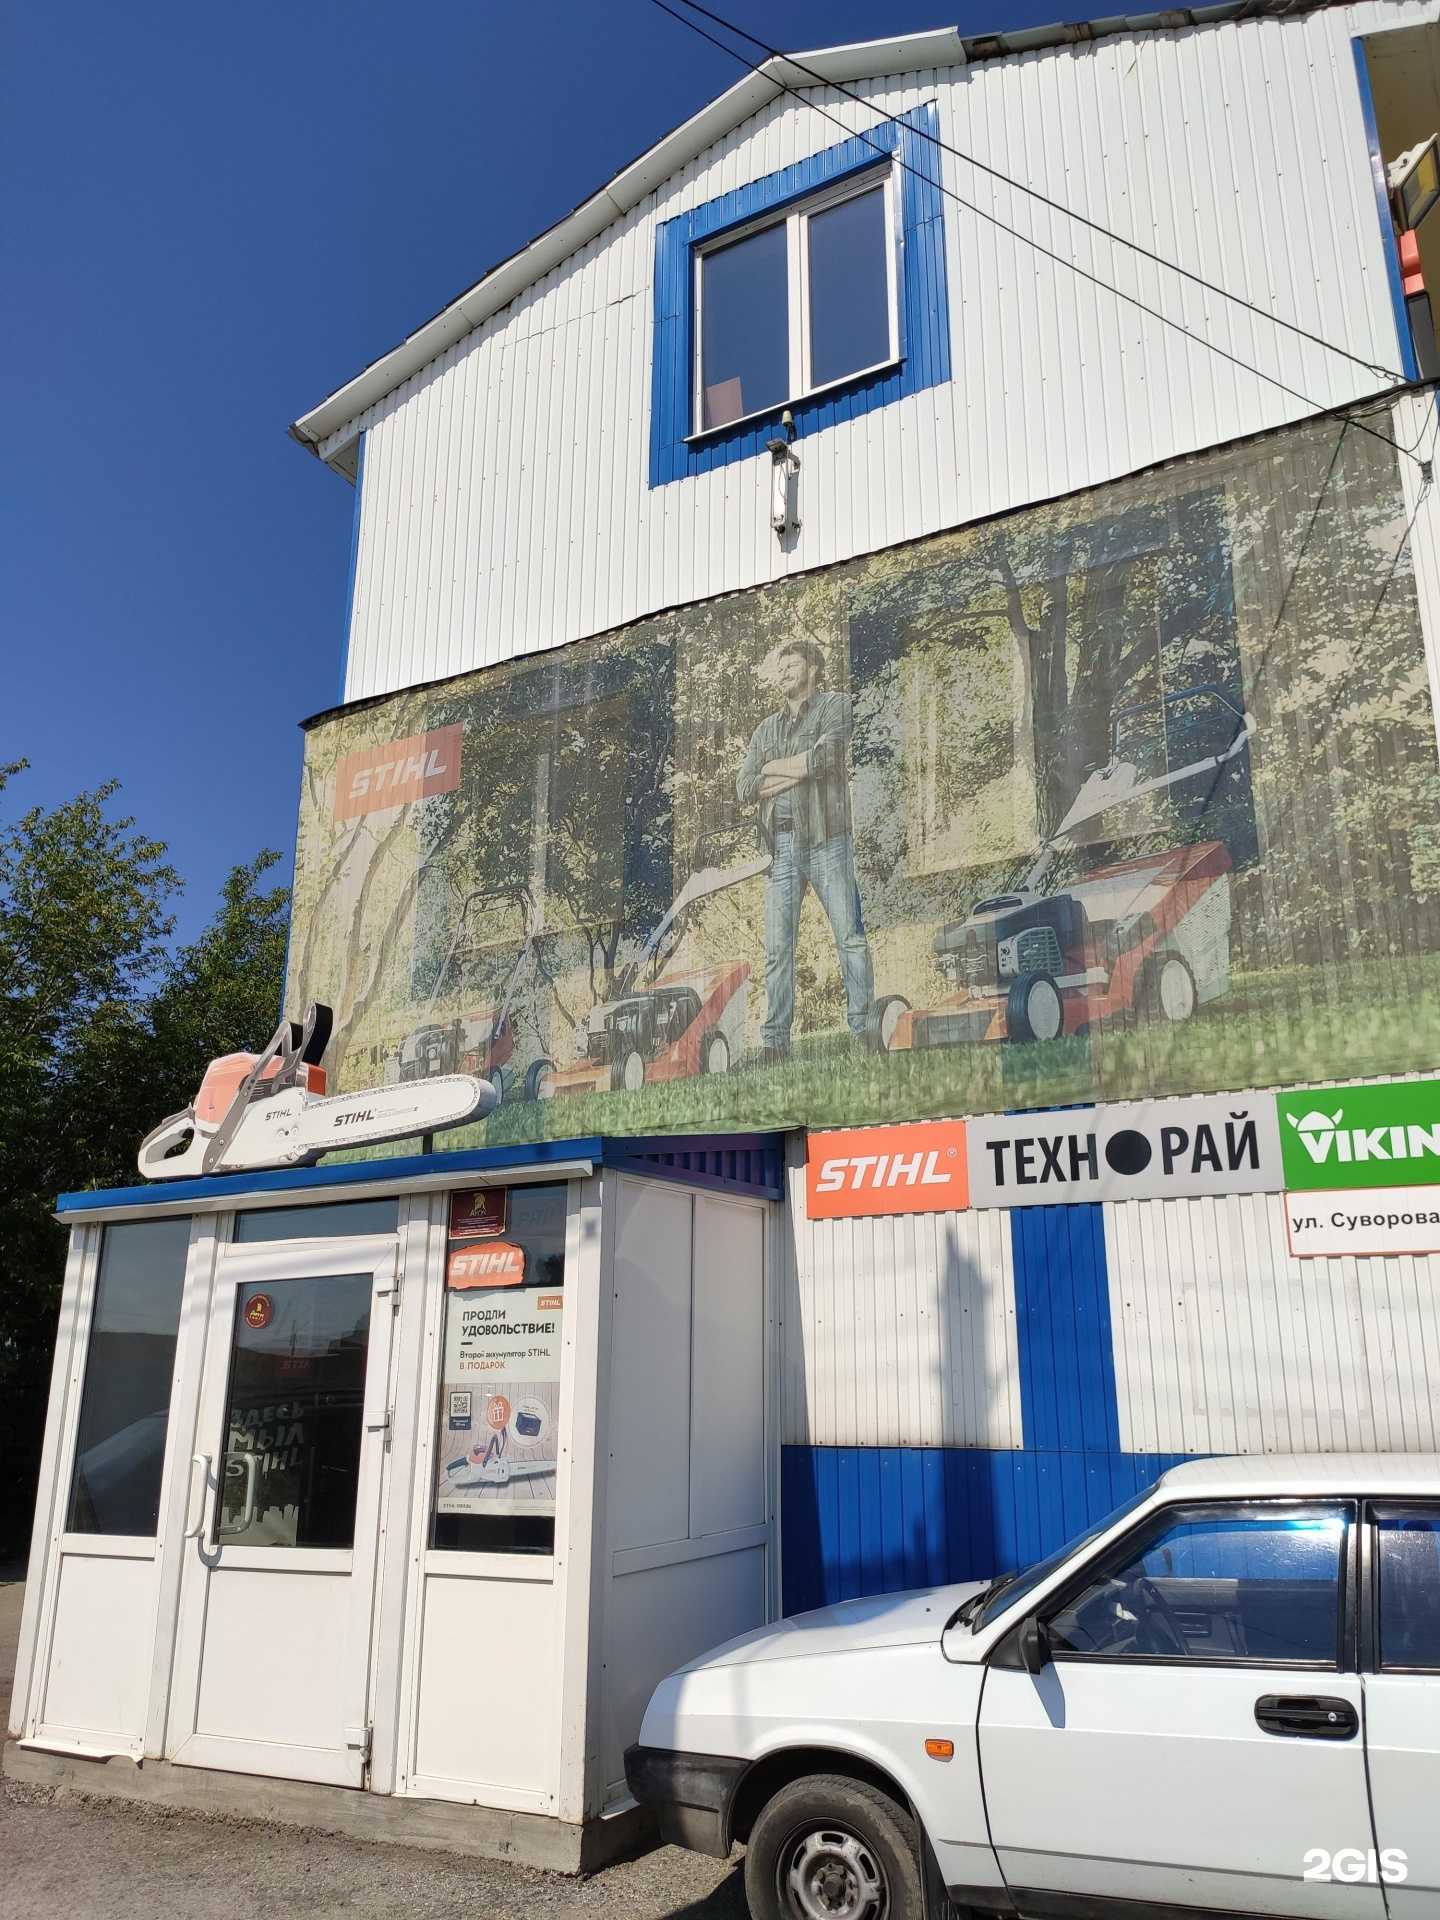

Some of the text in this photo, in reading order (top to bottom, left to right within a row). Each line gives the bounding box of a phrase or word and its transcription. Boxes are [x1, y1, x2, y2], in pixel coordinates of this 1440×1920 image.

[349, 749, 448, 799] STIHL
[265, 1108, 292, 1121] STIHL
[333, 1110, 375, 1127] STIHL
[816, 1151, 952, 1192] STIHL
[1292, 1211, 1440, 1233] ул. Суворова
[452, 1252, 520, 1276] STIHL
[462, 1310, 506, 1322] ПРОДЛИ
[462, 1322, 555, 1337] УДОВОЛЬСТВИЕ!
[460, 1348, 551, 1360] Второй аккумулятор STIHL
[459, 1361, 506, 1370] В ПОДАРОК
